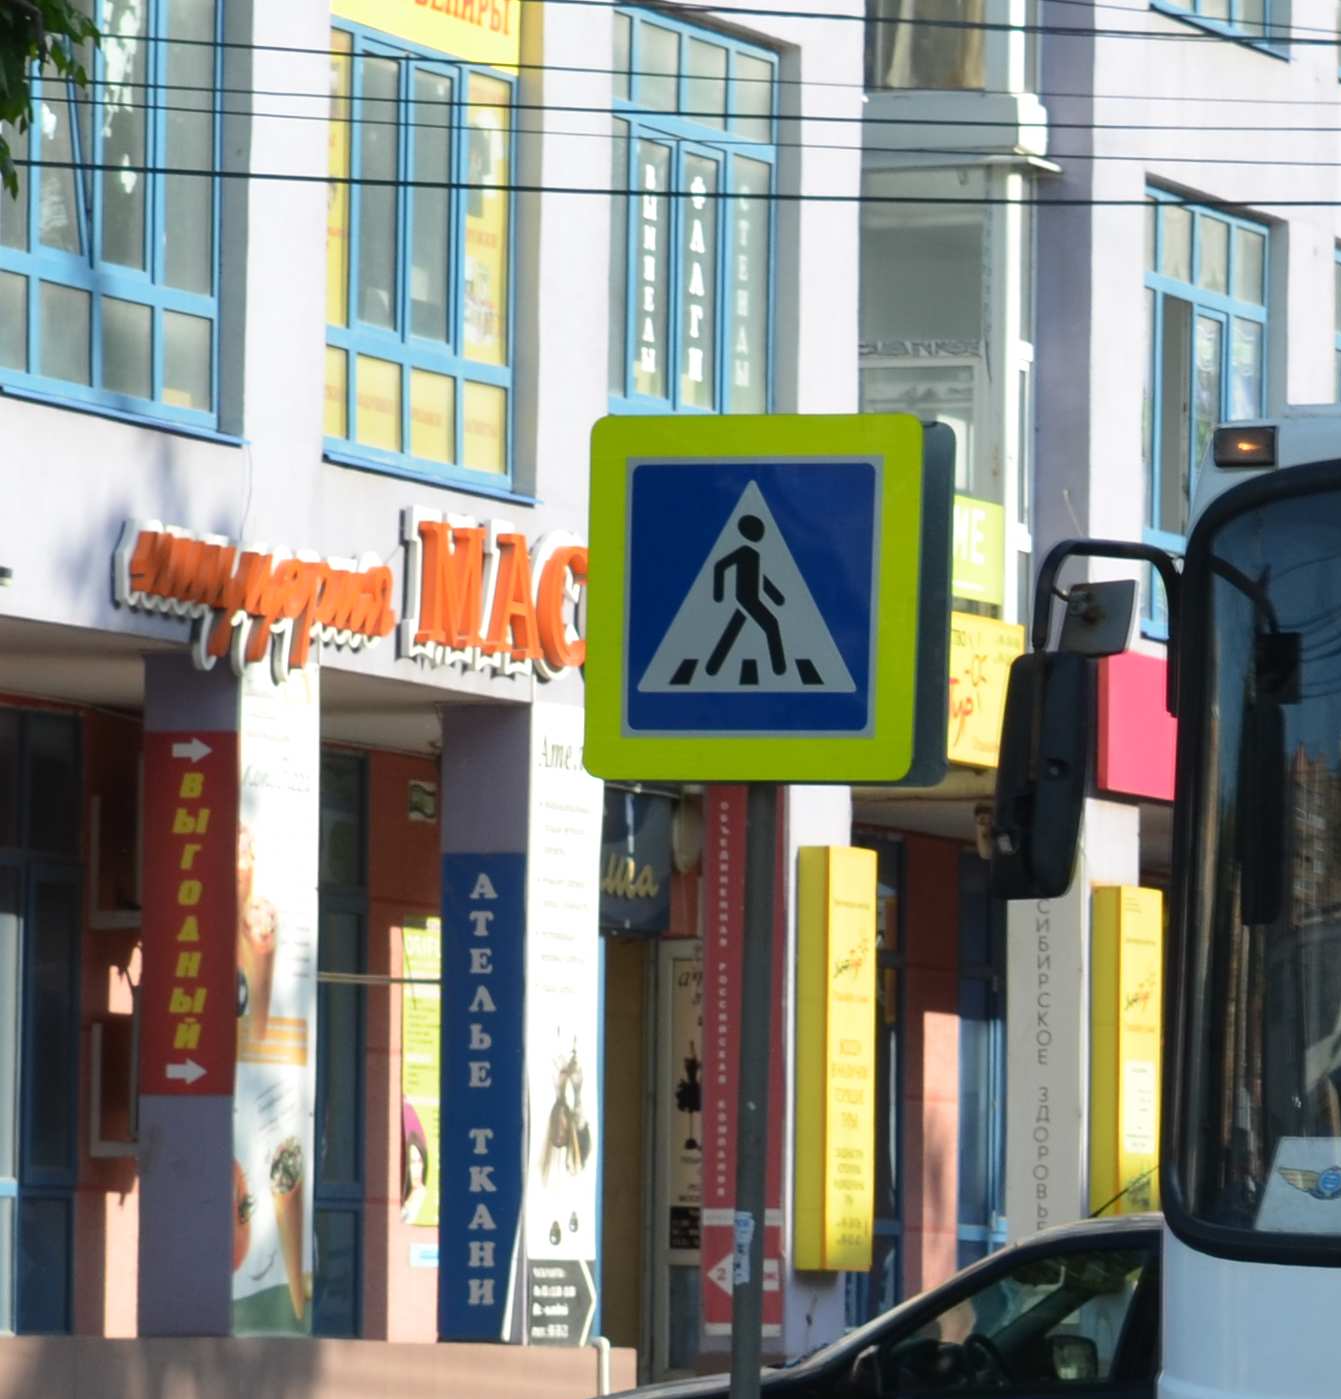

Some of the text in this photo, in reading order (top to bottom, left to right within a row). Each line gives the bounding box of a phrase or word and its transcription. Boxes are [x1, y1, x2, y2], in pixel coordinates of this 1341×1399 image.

[169, 772, 210, 1050] ВЫГОДНЫЙ
[1035, 899, 1052, 1066] СИБИРСКОЕ
[468, 873, 499, 1306] АТЕЛЬЕ ТКАНИ
